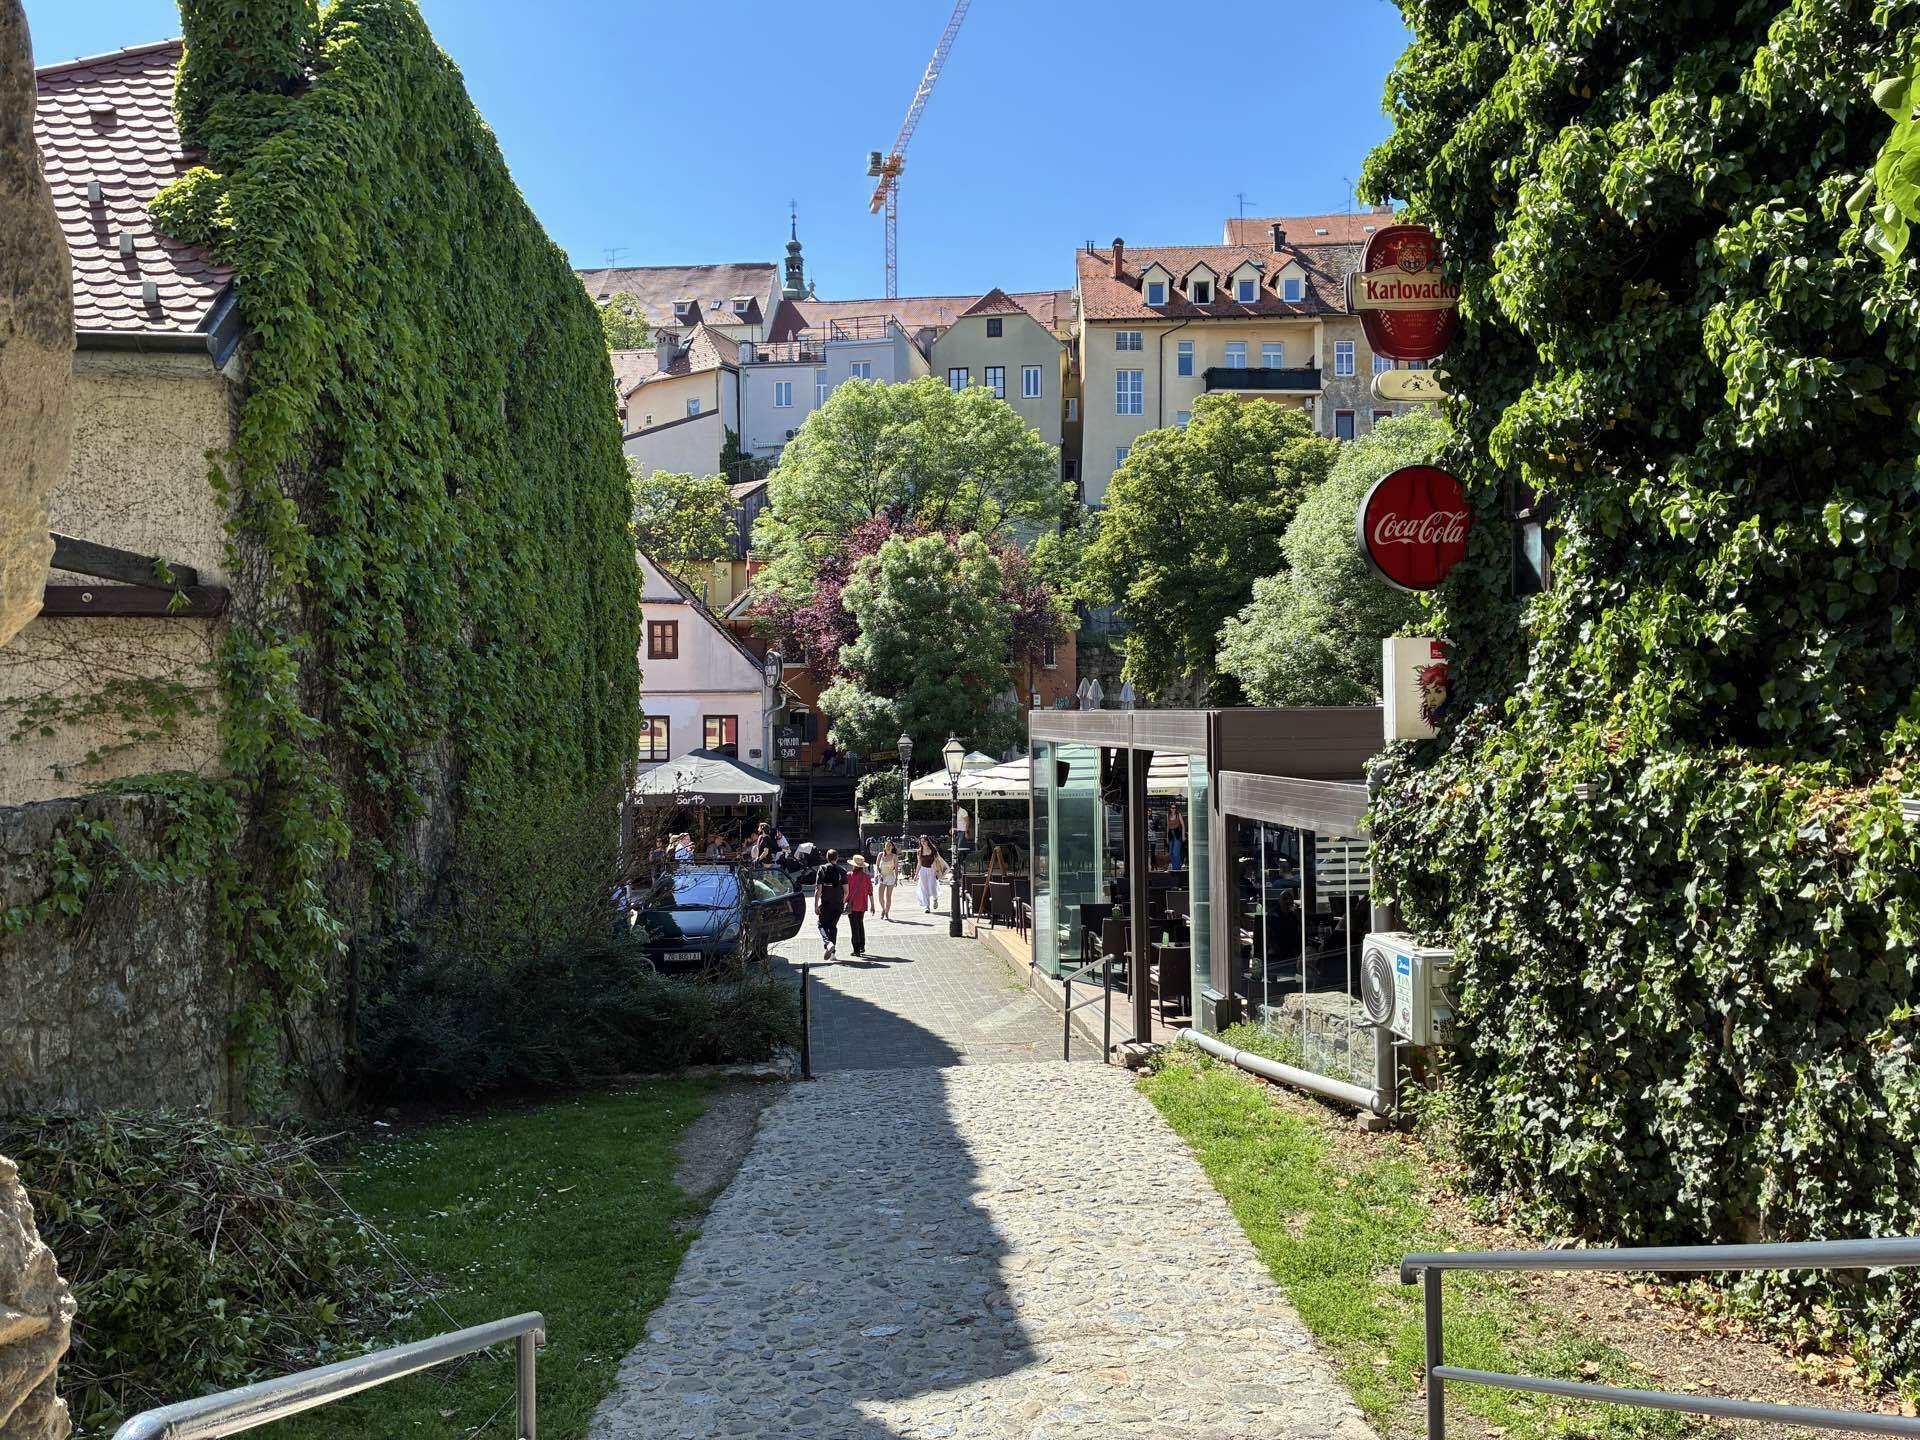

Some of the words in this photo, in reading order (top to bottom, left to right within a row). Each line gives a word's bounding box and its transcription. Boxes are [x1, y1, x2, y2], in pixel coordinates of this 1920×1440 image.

[1366, 278, 1458, 300] Karlovačko
[1374, 511, 1469, 545] Coca-Cola
[738, 794, 763, 804] Jana
